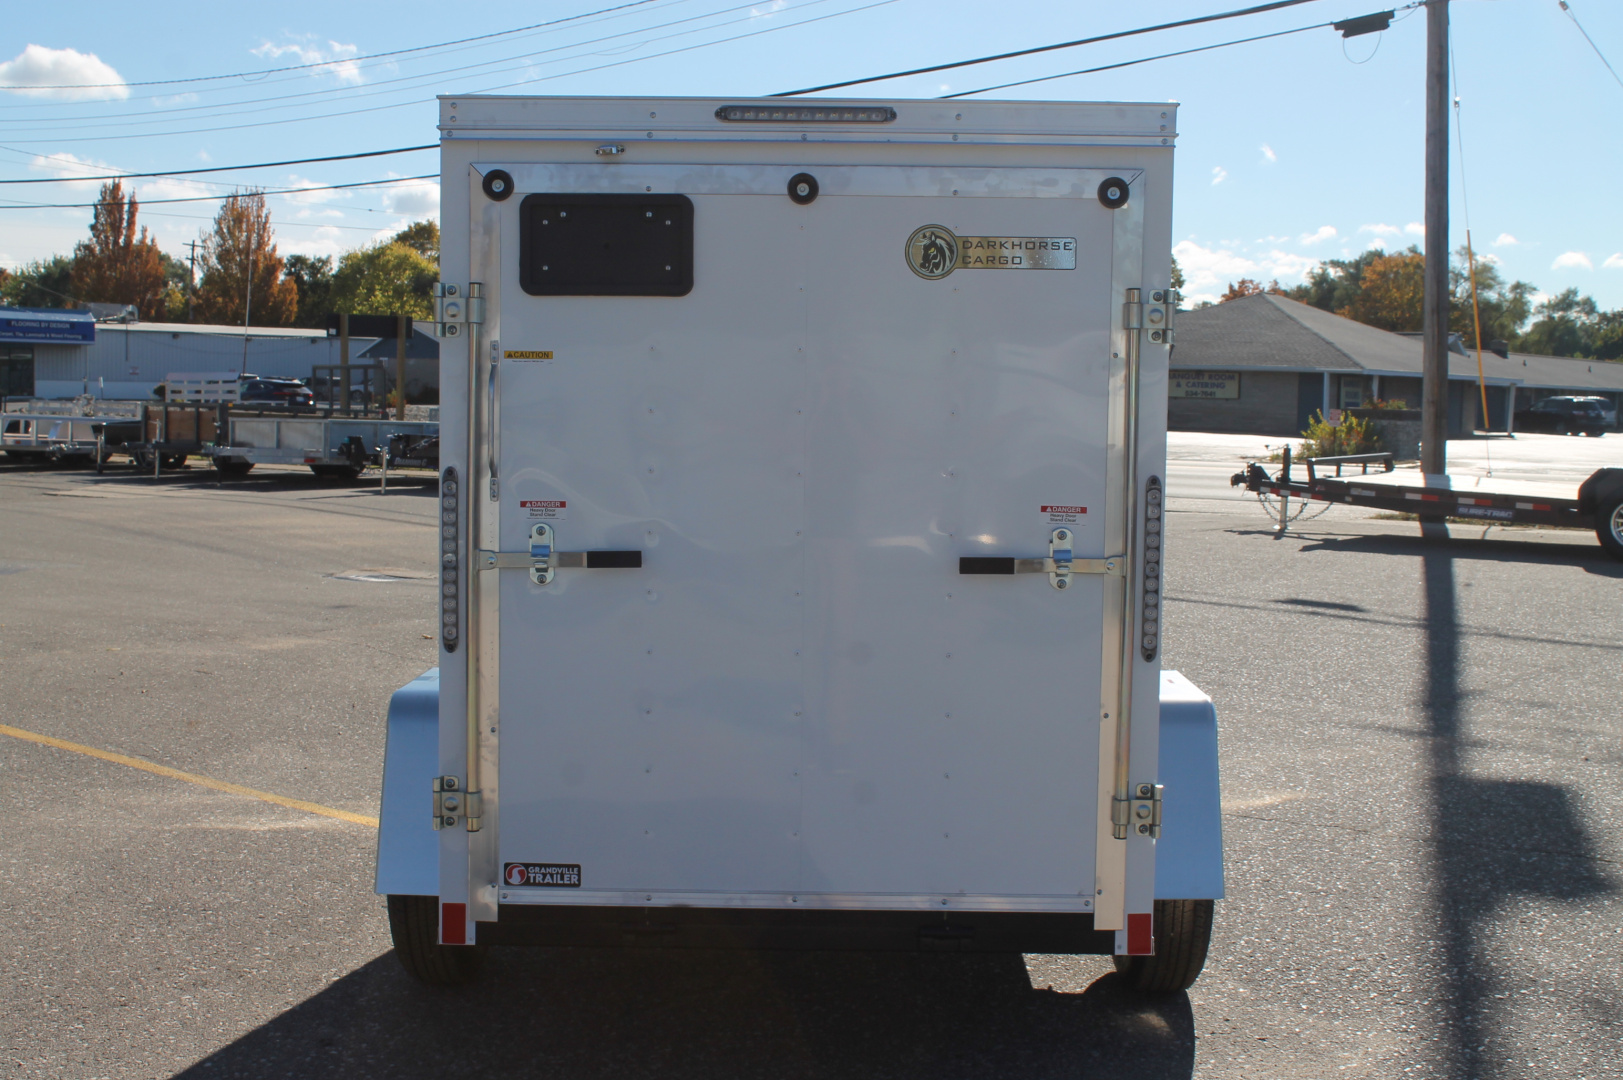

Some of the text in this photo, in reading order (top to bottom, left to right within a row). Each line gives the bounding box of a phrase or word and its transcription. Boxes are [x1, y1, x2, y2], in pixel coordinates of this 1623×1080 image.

[962, 240, 1073, 251] DARKHORSE
[962, 255, 1022, 265] CARGO
[11, 320, 40, 328] FLOORING
[513, 351, 549, 359] CAUTION
[1176, 380, 1226, 389] & CATERING
[1458, 507, 1513, 518] SURE-TRAC
[528, 866, 578, 874] GRANDVILLE
[528, 873, 579, 884] TRAILER
